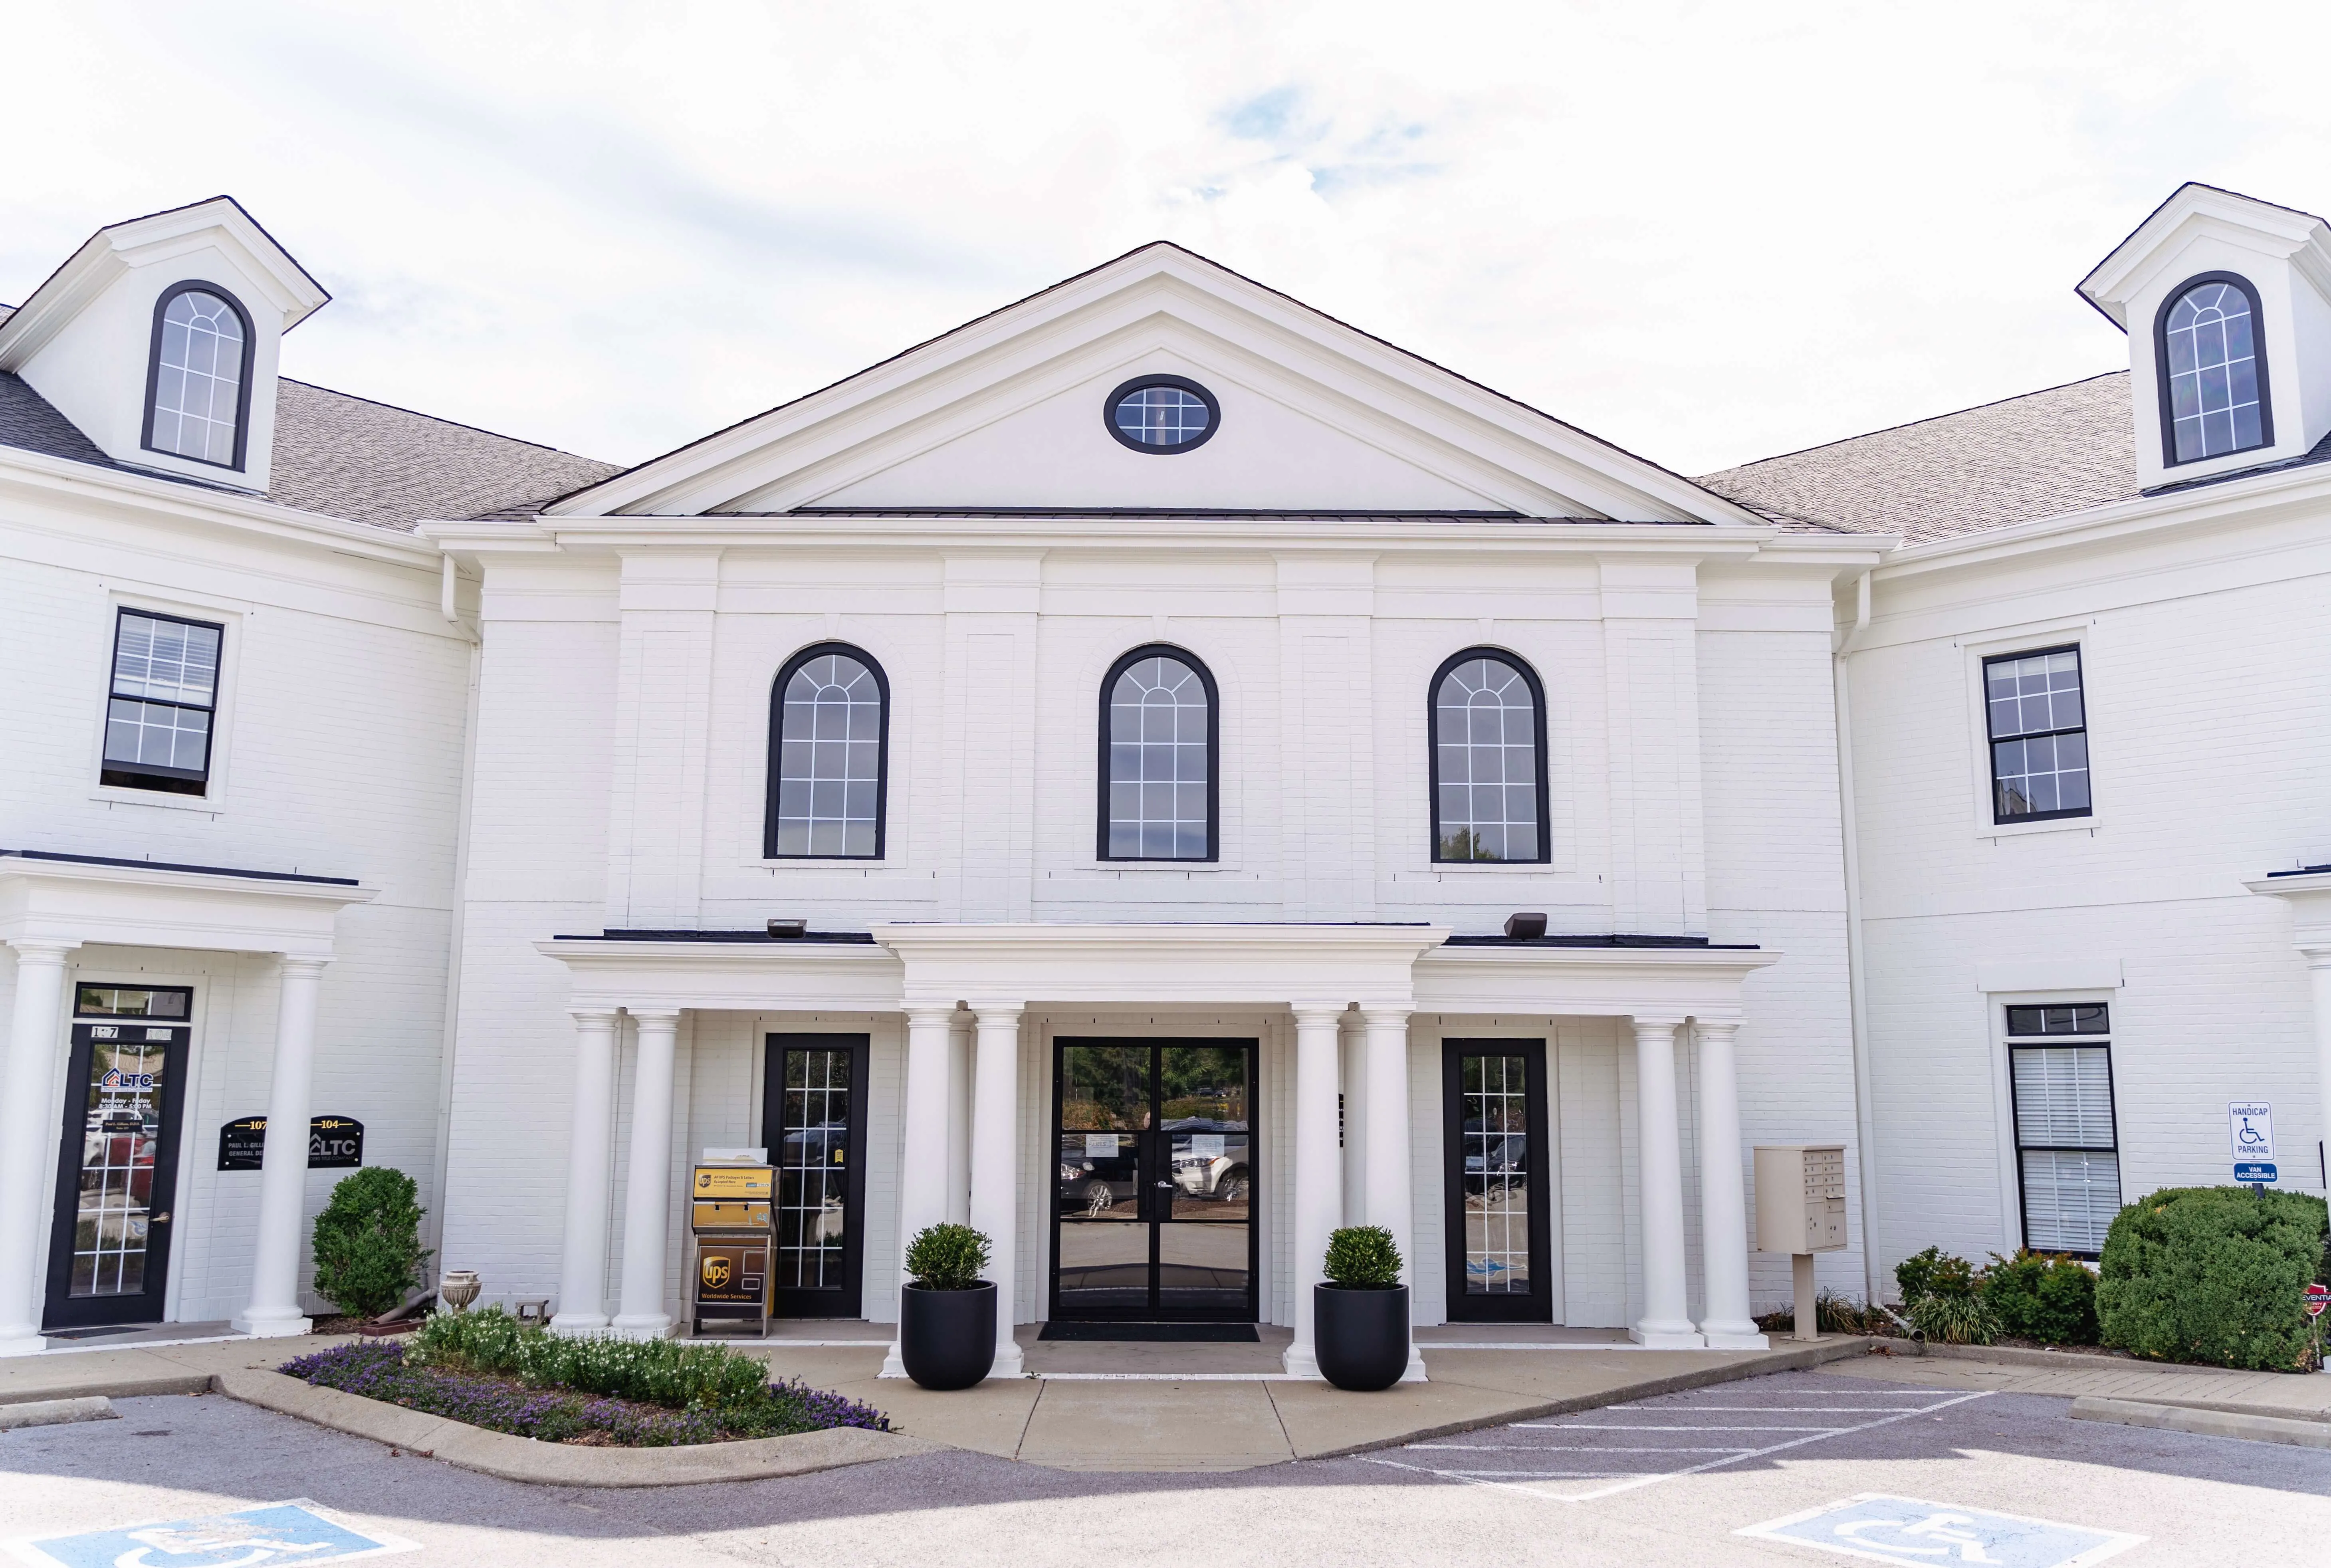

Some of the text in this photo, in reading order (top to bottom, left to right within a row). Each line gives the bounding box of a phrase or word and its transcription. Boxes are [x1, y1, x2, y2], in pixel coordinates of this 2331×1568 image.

[94, 1028, 117, 1037] 17
[120, 1074, 153, 1087] LTC
[250, 1121, 267, 1130] 107
[321, 1120, 339, 1128] 104
[321, 1140, 356, 1155] LTC
[700, 1177, 711, 1186] ups
[705, 1266, 728, 1284] ups
